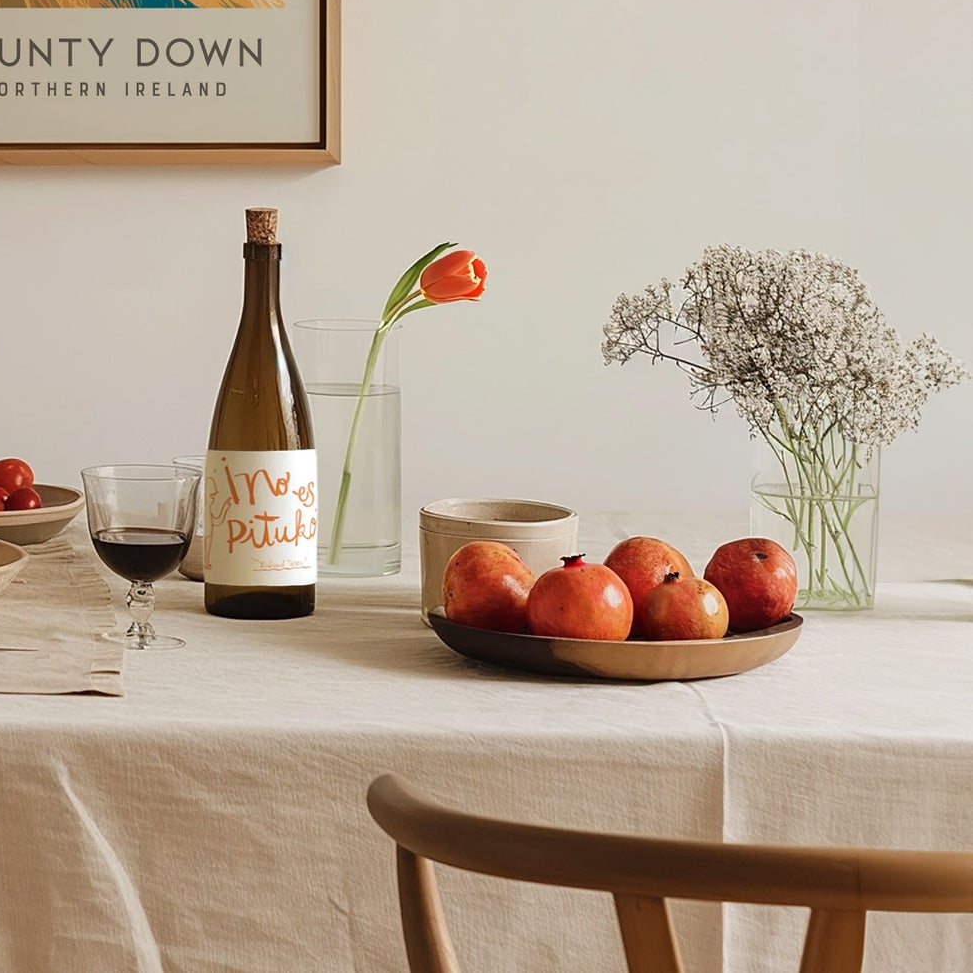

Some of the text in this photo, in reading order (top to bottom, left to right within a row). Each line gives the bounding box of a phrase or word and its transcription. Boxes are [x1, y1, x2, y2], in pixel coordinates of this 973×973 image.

[136, 37, 263, 68] DOWN
[125, 81, 227, 97] IRELAND
[292, 481, 315, 508] es
